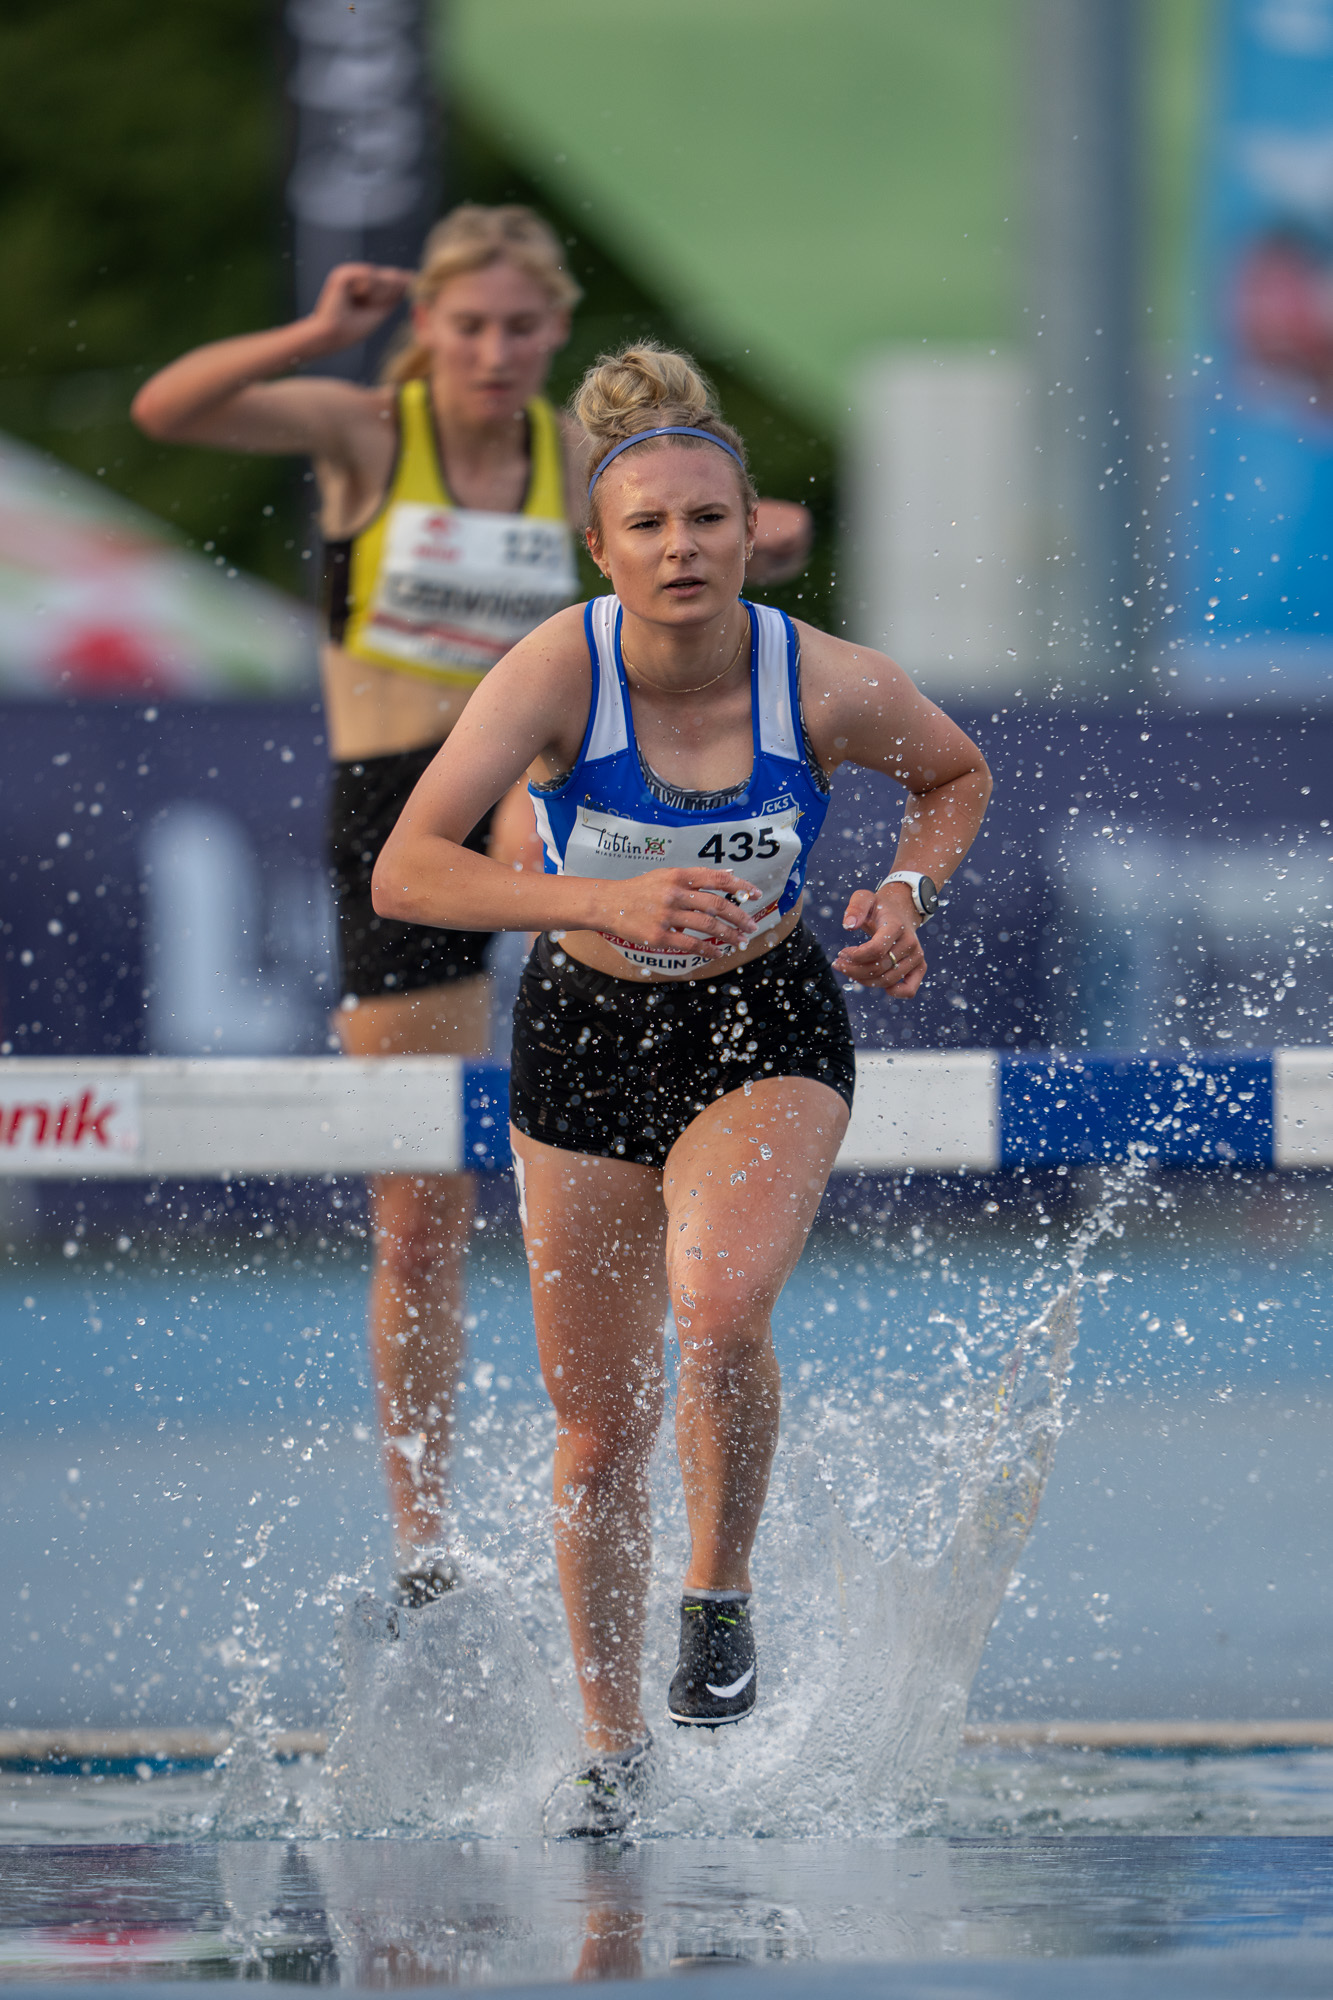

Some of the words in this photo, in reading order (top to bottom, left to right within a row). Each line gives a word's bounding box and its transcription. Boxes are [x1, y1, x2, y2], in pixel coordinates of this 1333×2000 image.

[766, 797, 789, 813] CKS
[595, 850, 622, 858] MIASTO
[697, 826, 780, 864] 435
[624, 951, 688, 970] LUBLIN
[0, 1084, 117, 1147] nik
